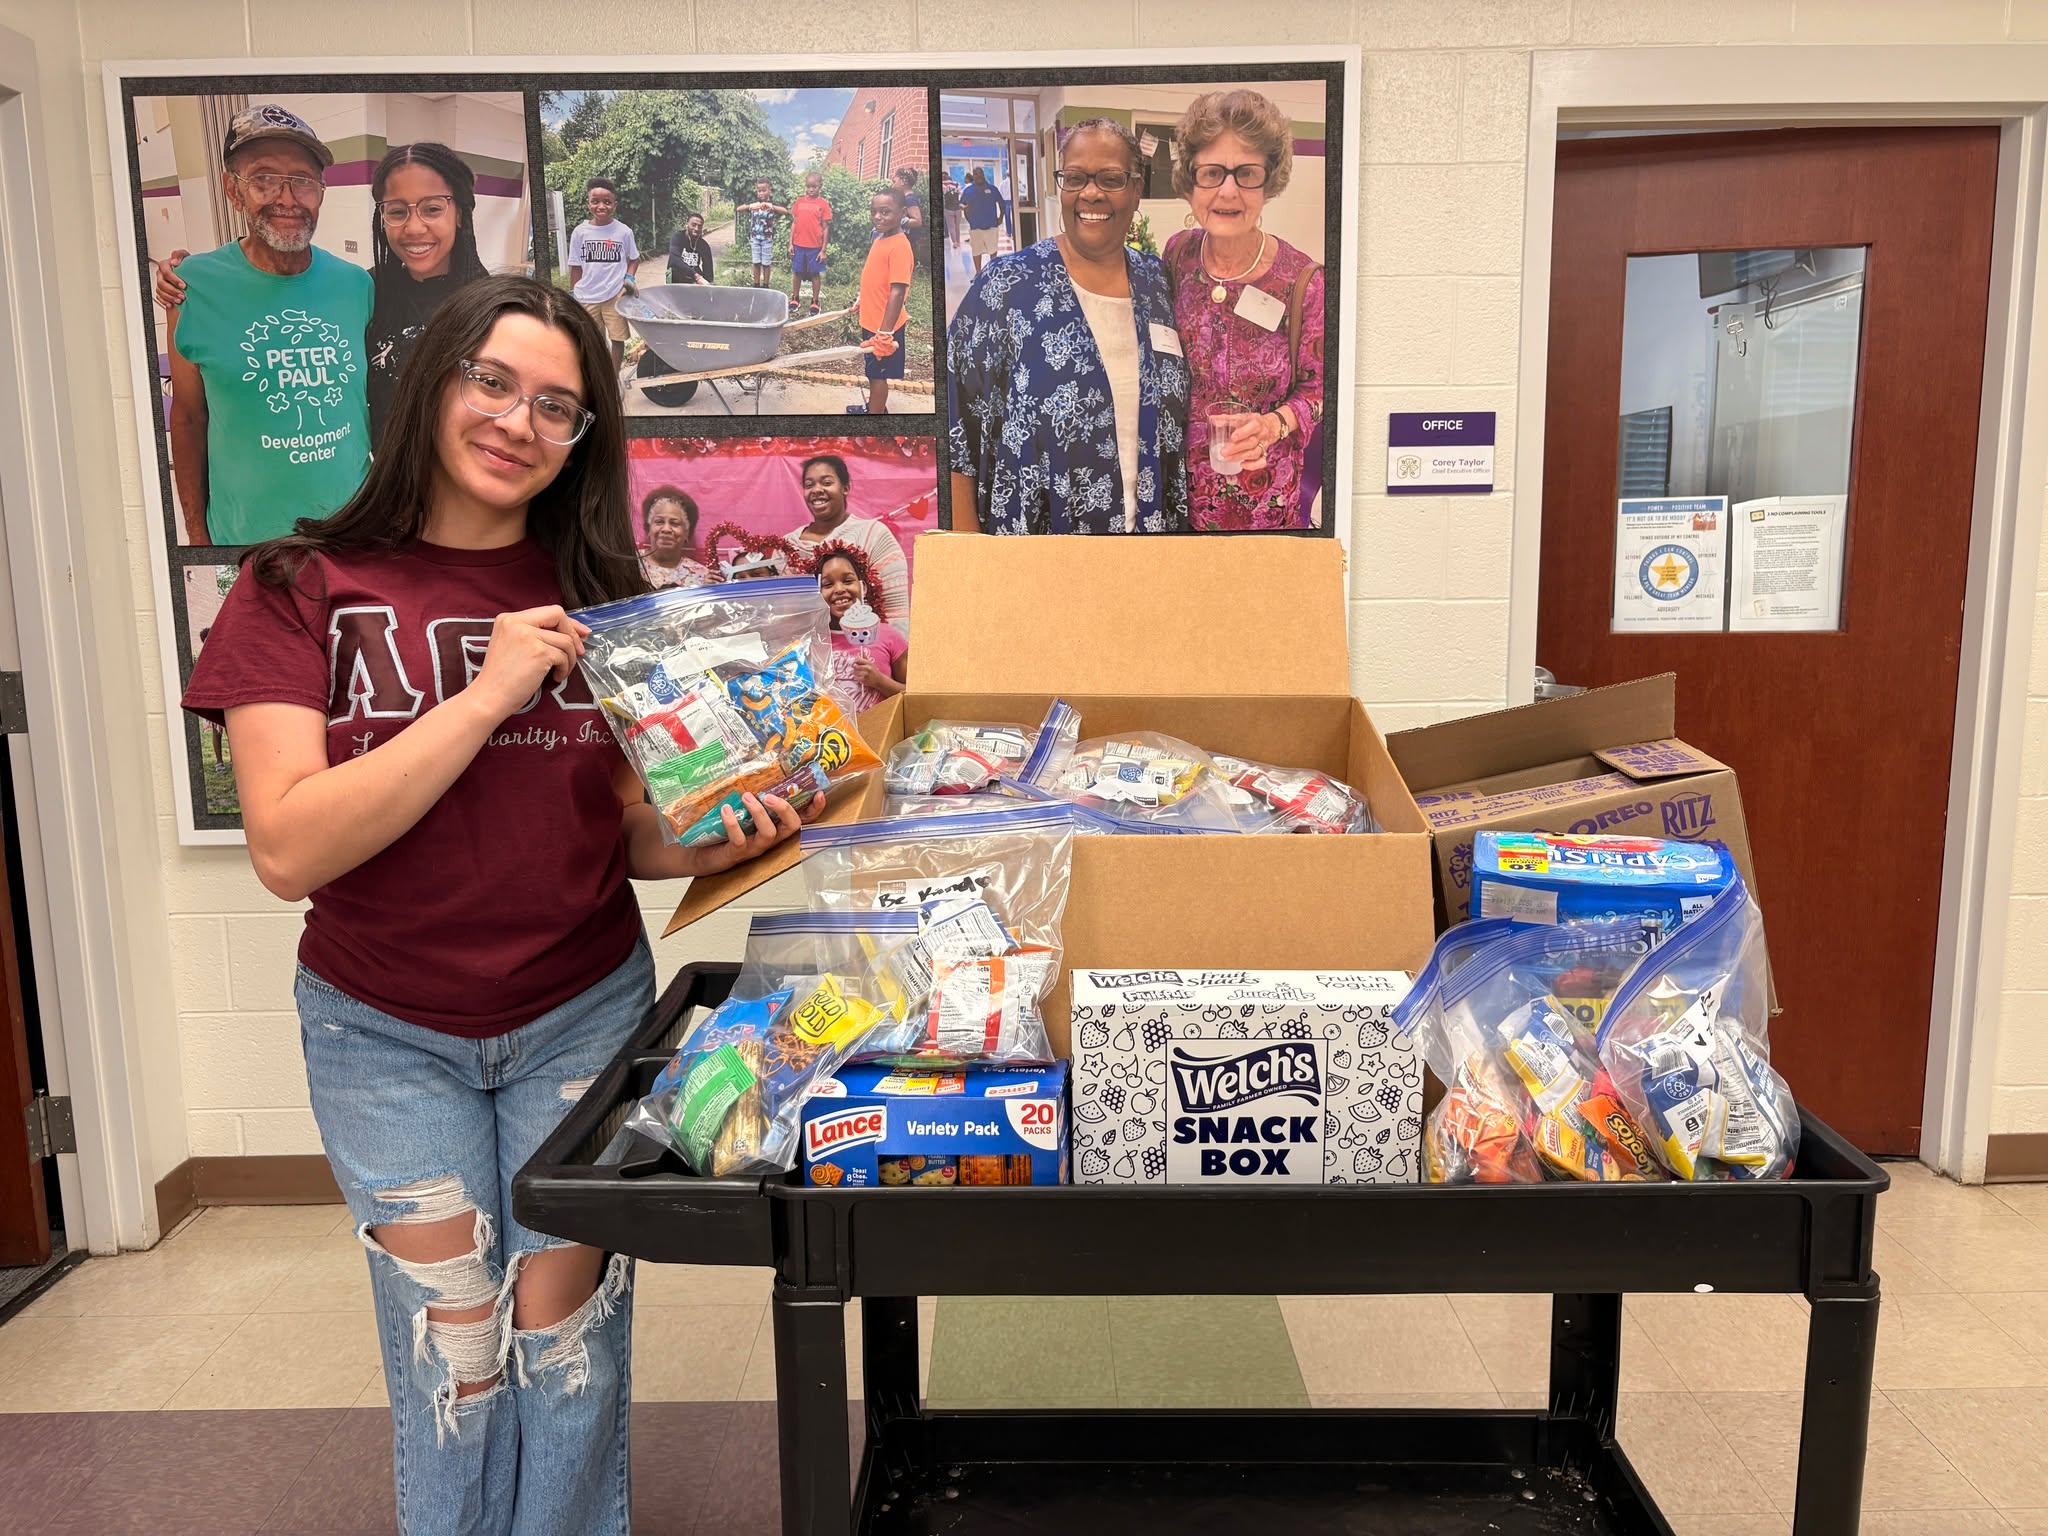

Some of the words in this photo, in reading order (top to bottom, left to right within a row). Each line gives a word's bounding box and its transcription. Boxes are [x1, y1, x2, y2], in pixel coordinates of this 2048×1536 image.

[266, 346, 339, 370] PETER
[278, 366, 335, 389] PAUL
[261, 422, 351, 449] Development
[1422, 419, 1463, 430] OFFICE
[289, 446, 336, 464] Center
[1432, 459, 1456, 467] Corey
[1459, 459, 1485, 467] Taylor
[1568, 801, 1654, 835] OREO
[1661, 793, 1717, 835] RITZ
[1509, 863, 1537, 872] 30
[878, 893, 906, 908] Be
[918, 876, 977, 902] Kind
[1097, 971, 1179, 987] Welch's
[1187, 975, 1261, 986] Snacks
[1199, 971, 1248, 980] Fruit
[1318, 981, 1394, 990] Yogurt
[812, 988, 843, 1018] ROLD
[1176, 1047, 1315, 1105] Welch's
[988, 1083, 1036, 1095] Lance
[1212, 1100, 1235, 1110] FAMILY
[1236, 1090, 1263, 1103] FARMER
[1263, 1084, 1288, 1095] OWNED
[1020, 1103, 1054, 1125] 20
[809, 1113, 883, 1150] Lance
[906, 1120, 960, 1137] Variety
[964, 1120, 1000, 1137] Pack
[1023, 1126, 1052, 1135] PACKS
[1173, 1116, 1318, 1145] SNACK
[1545, 1119, 1562, 1157] Lance
[1200, 1148, 1291, 1176] BOX
[846, 1173, 853, 1182] 8
